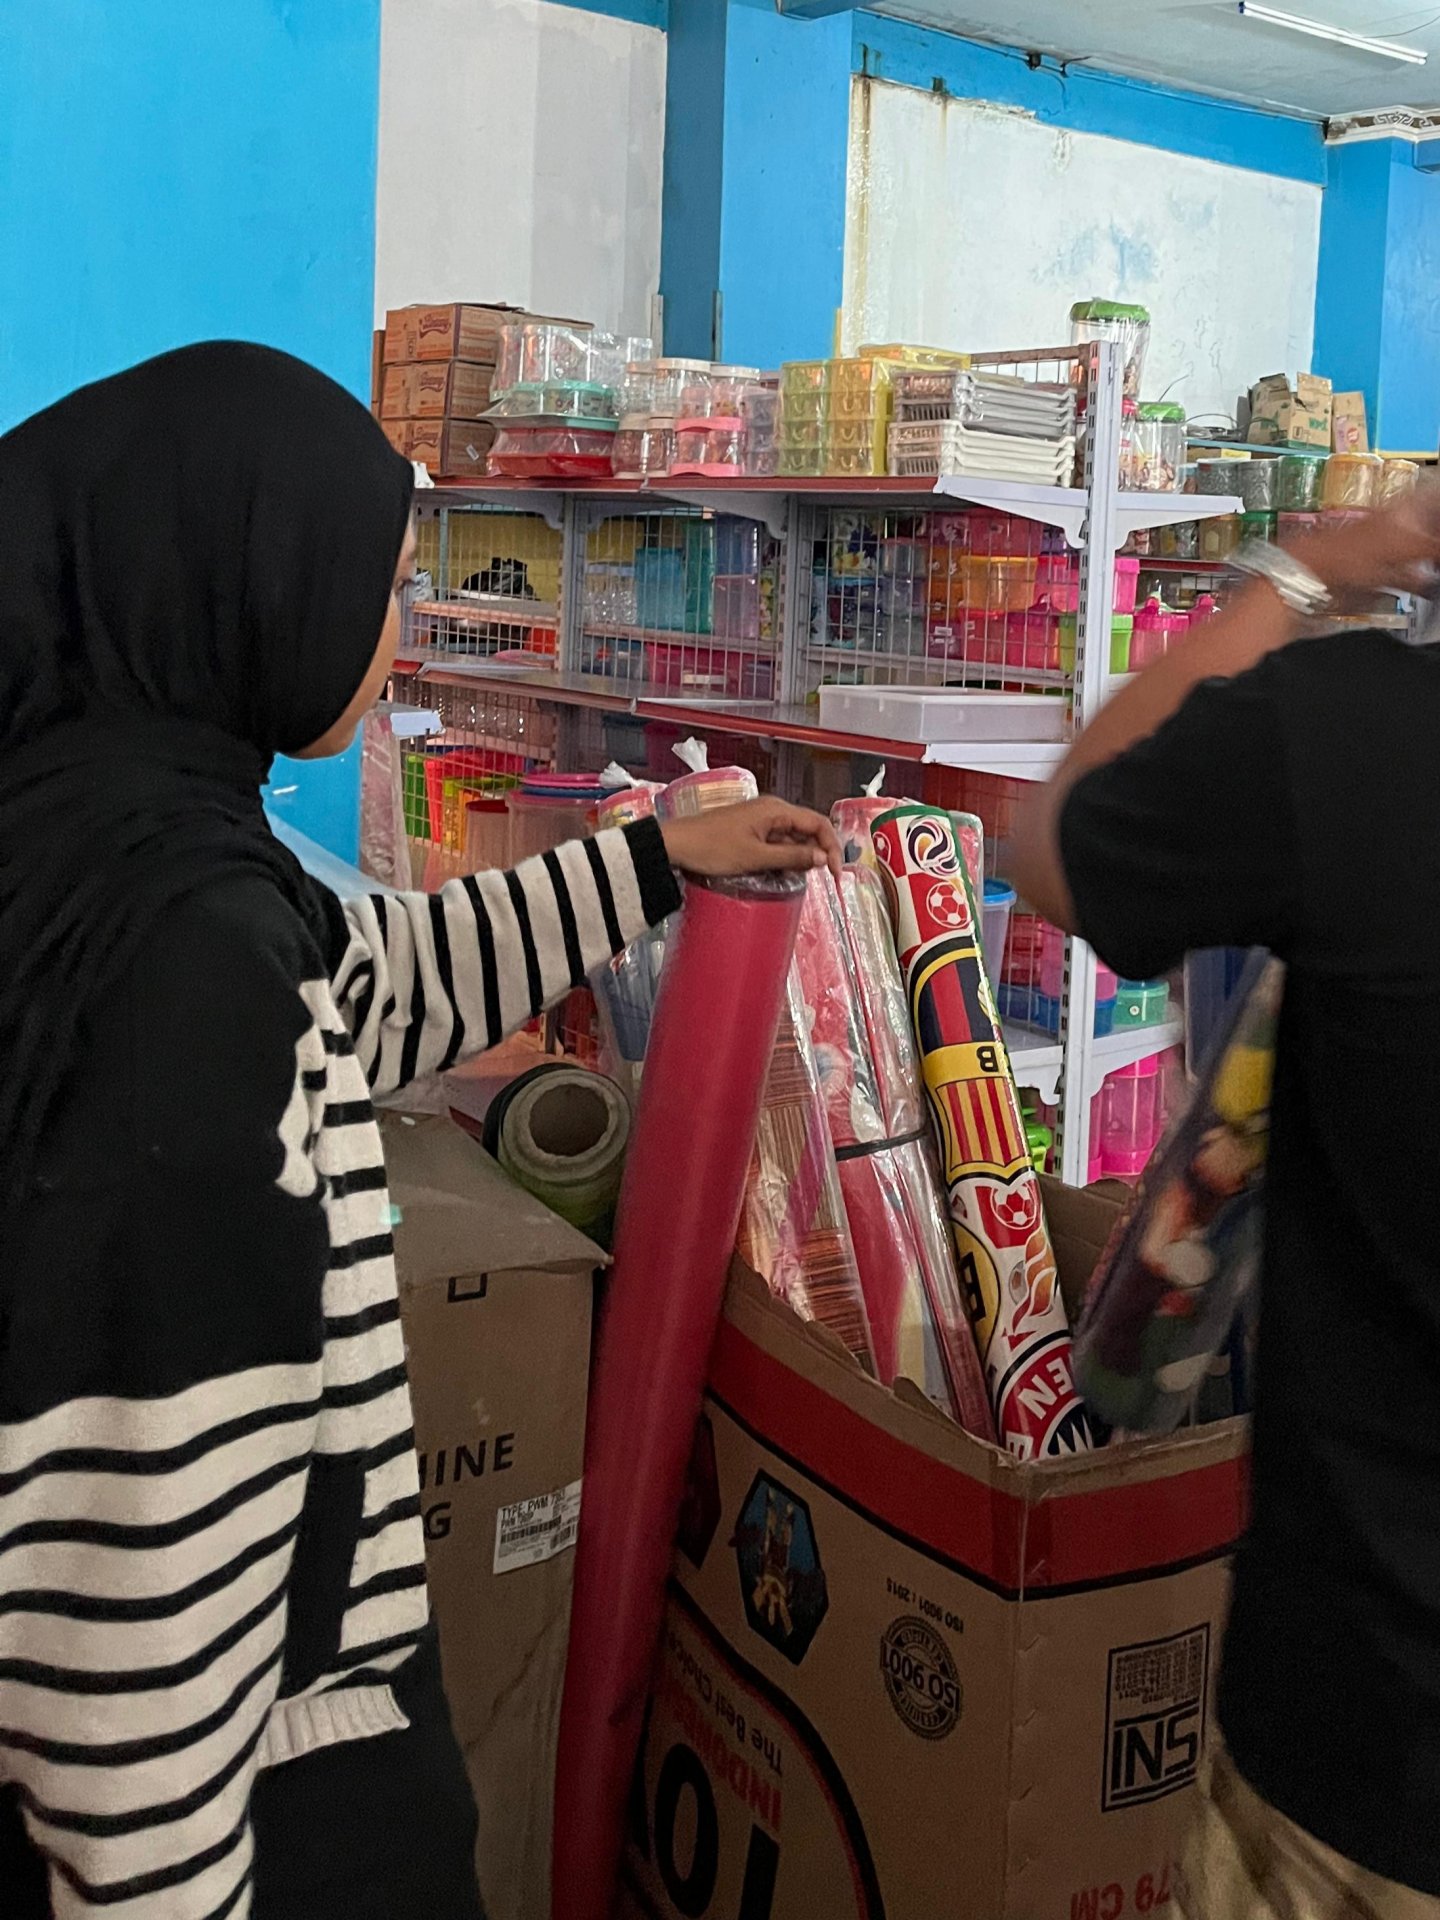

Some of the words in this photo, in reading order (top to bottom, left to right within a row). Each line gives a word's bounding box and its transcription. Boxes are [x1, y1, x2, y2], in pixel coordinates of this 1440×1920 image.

[976, 1045, 999, 1072] B
[944, 1611, 964, 1634] ISO
[883, 1640, 925, 1691] 9001
[928, 1673, 961, 1714] ISO
[751, 1728, 783, 1778] The
[1110, 1706, 1200, 1791] SNI
